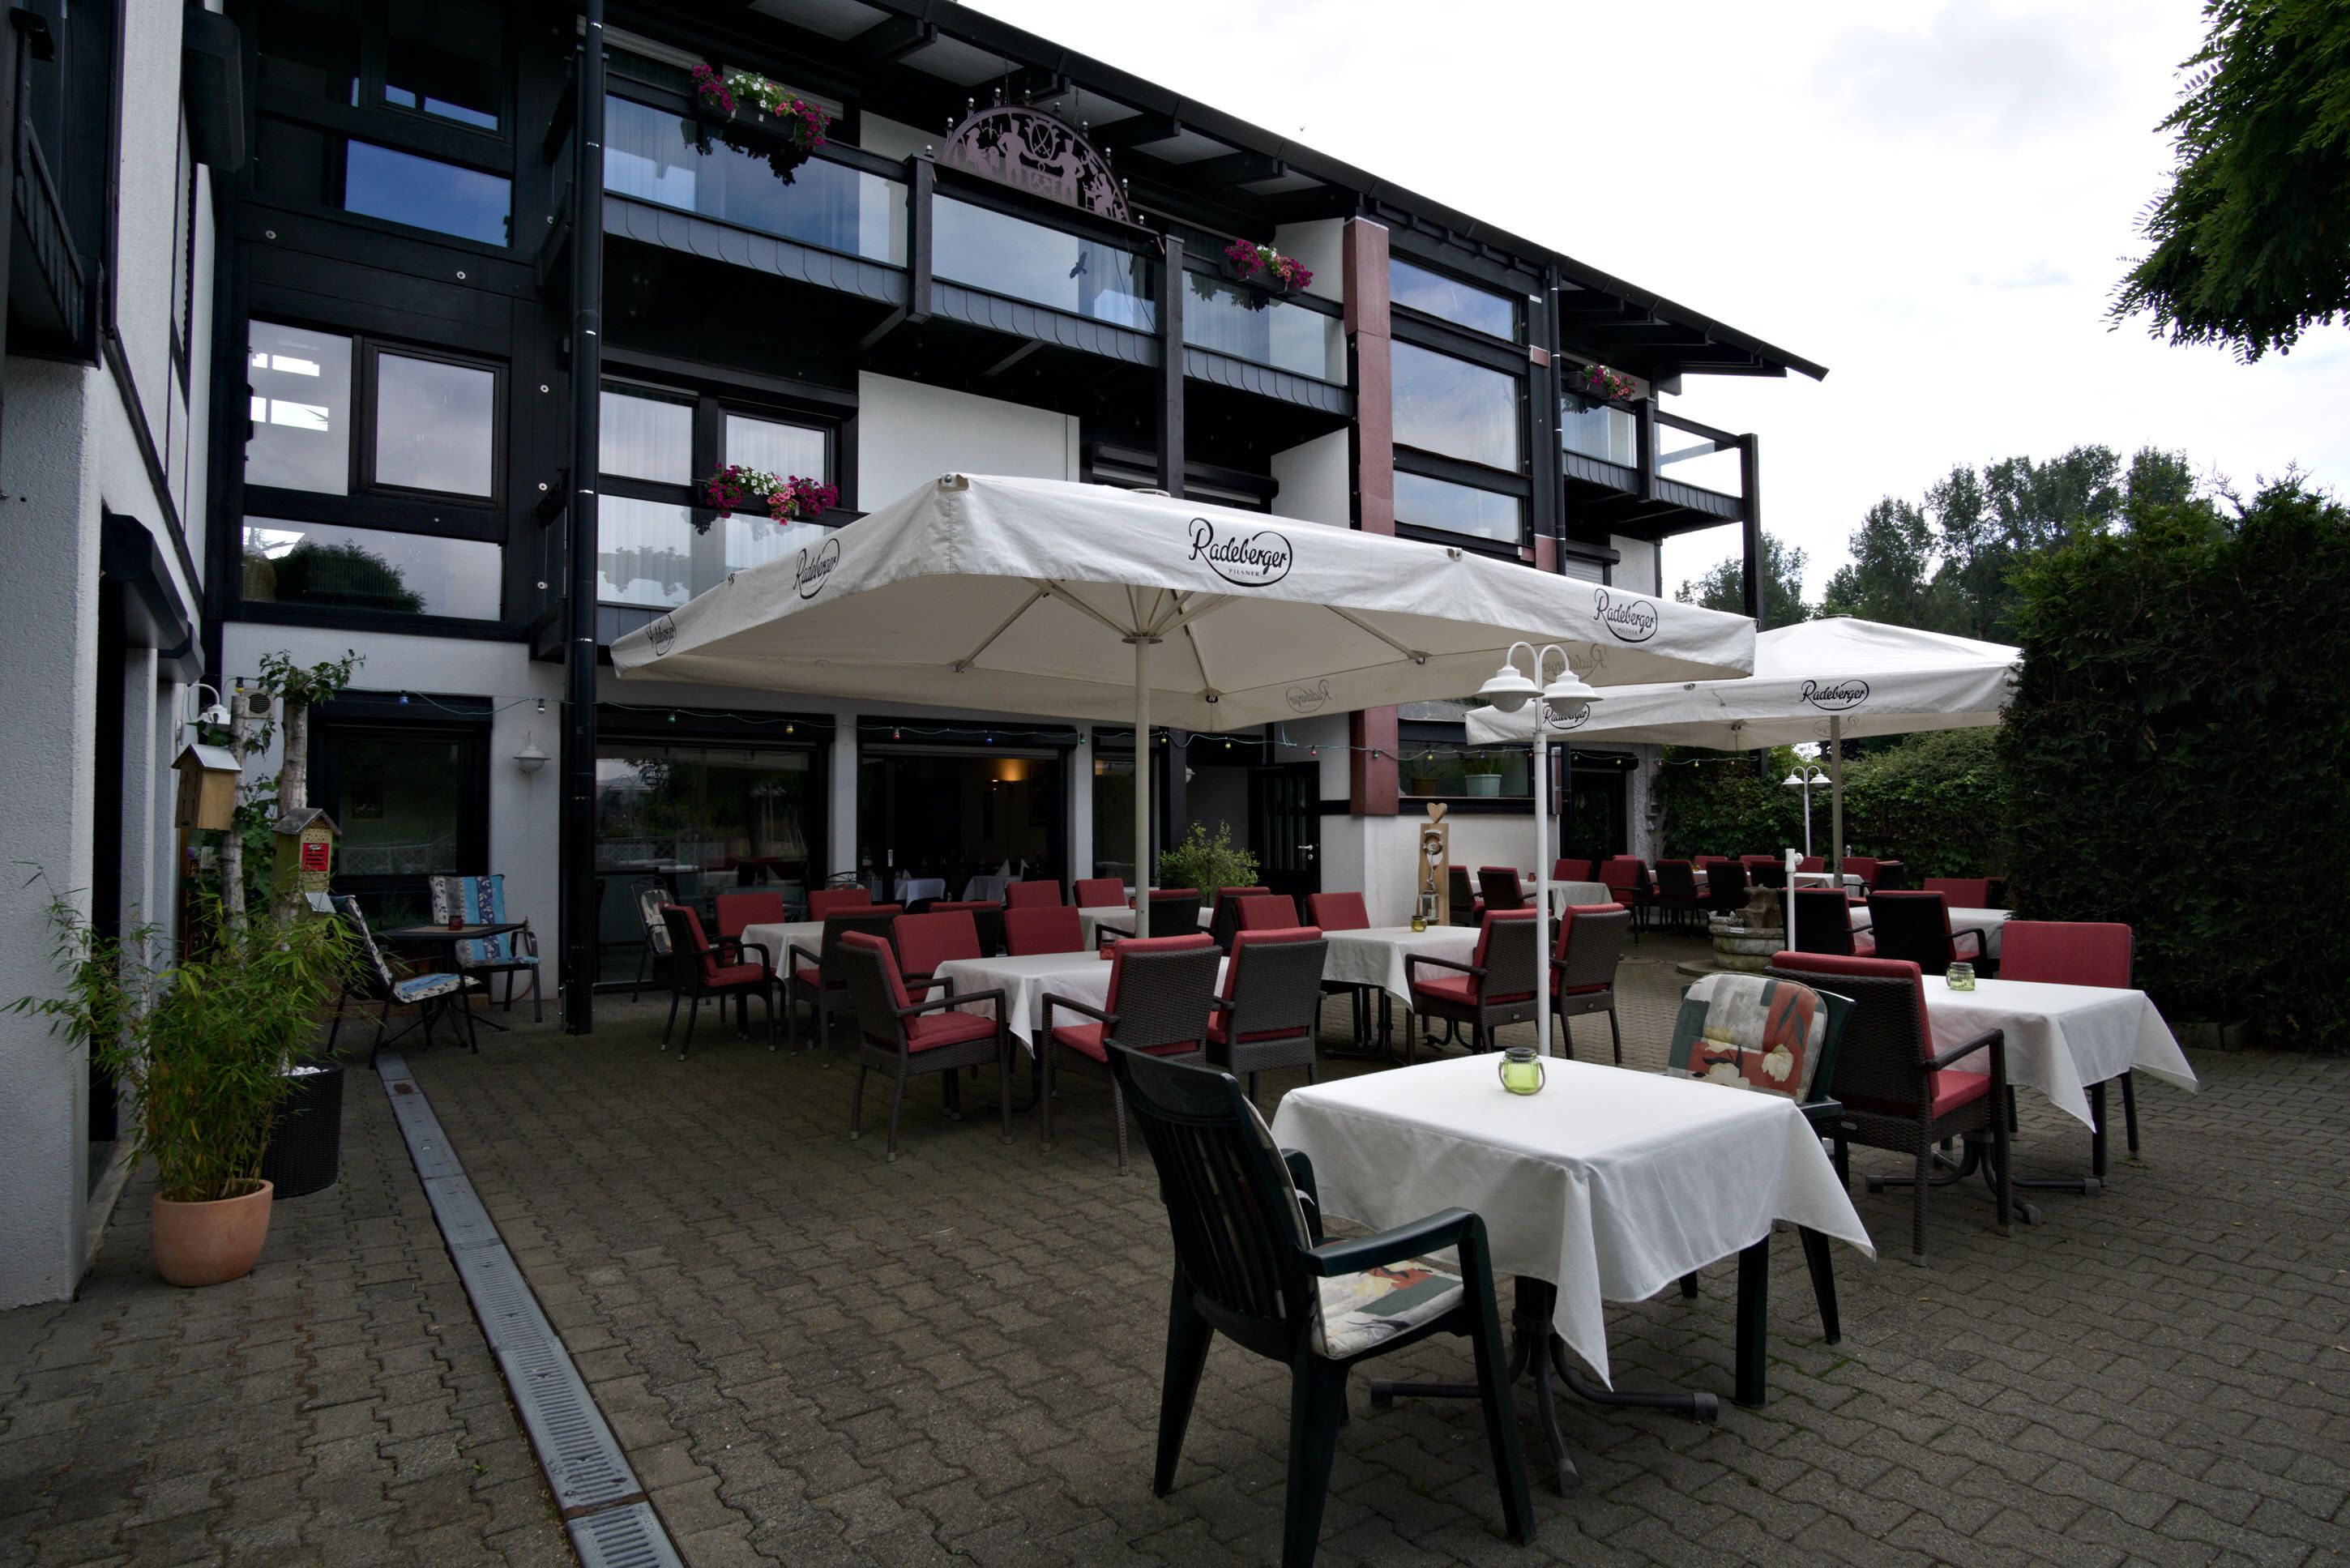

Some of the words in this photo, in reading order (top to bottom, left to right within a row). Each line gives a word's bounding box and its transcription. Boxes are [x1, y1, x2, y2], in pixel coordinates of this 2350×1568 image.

[793, 541, 840, 592] Radeberger
[1188, 517, 1291, 579] Radeberger
[1228, 568, 1260, 577] PILSNER
[1594, 587, 1656, 635] Radeberger
[1800, 679, 1867, 704] Radeberger
